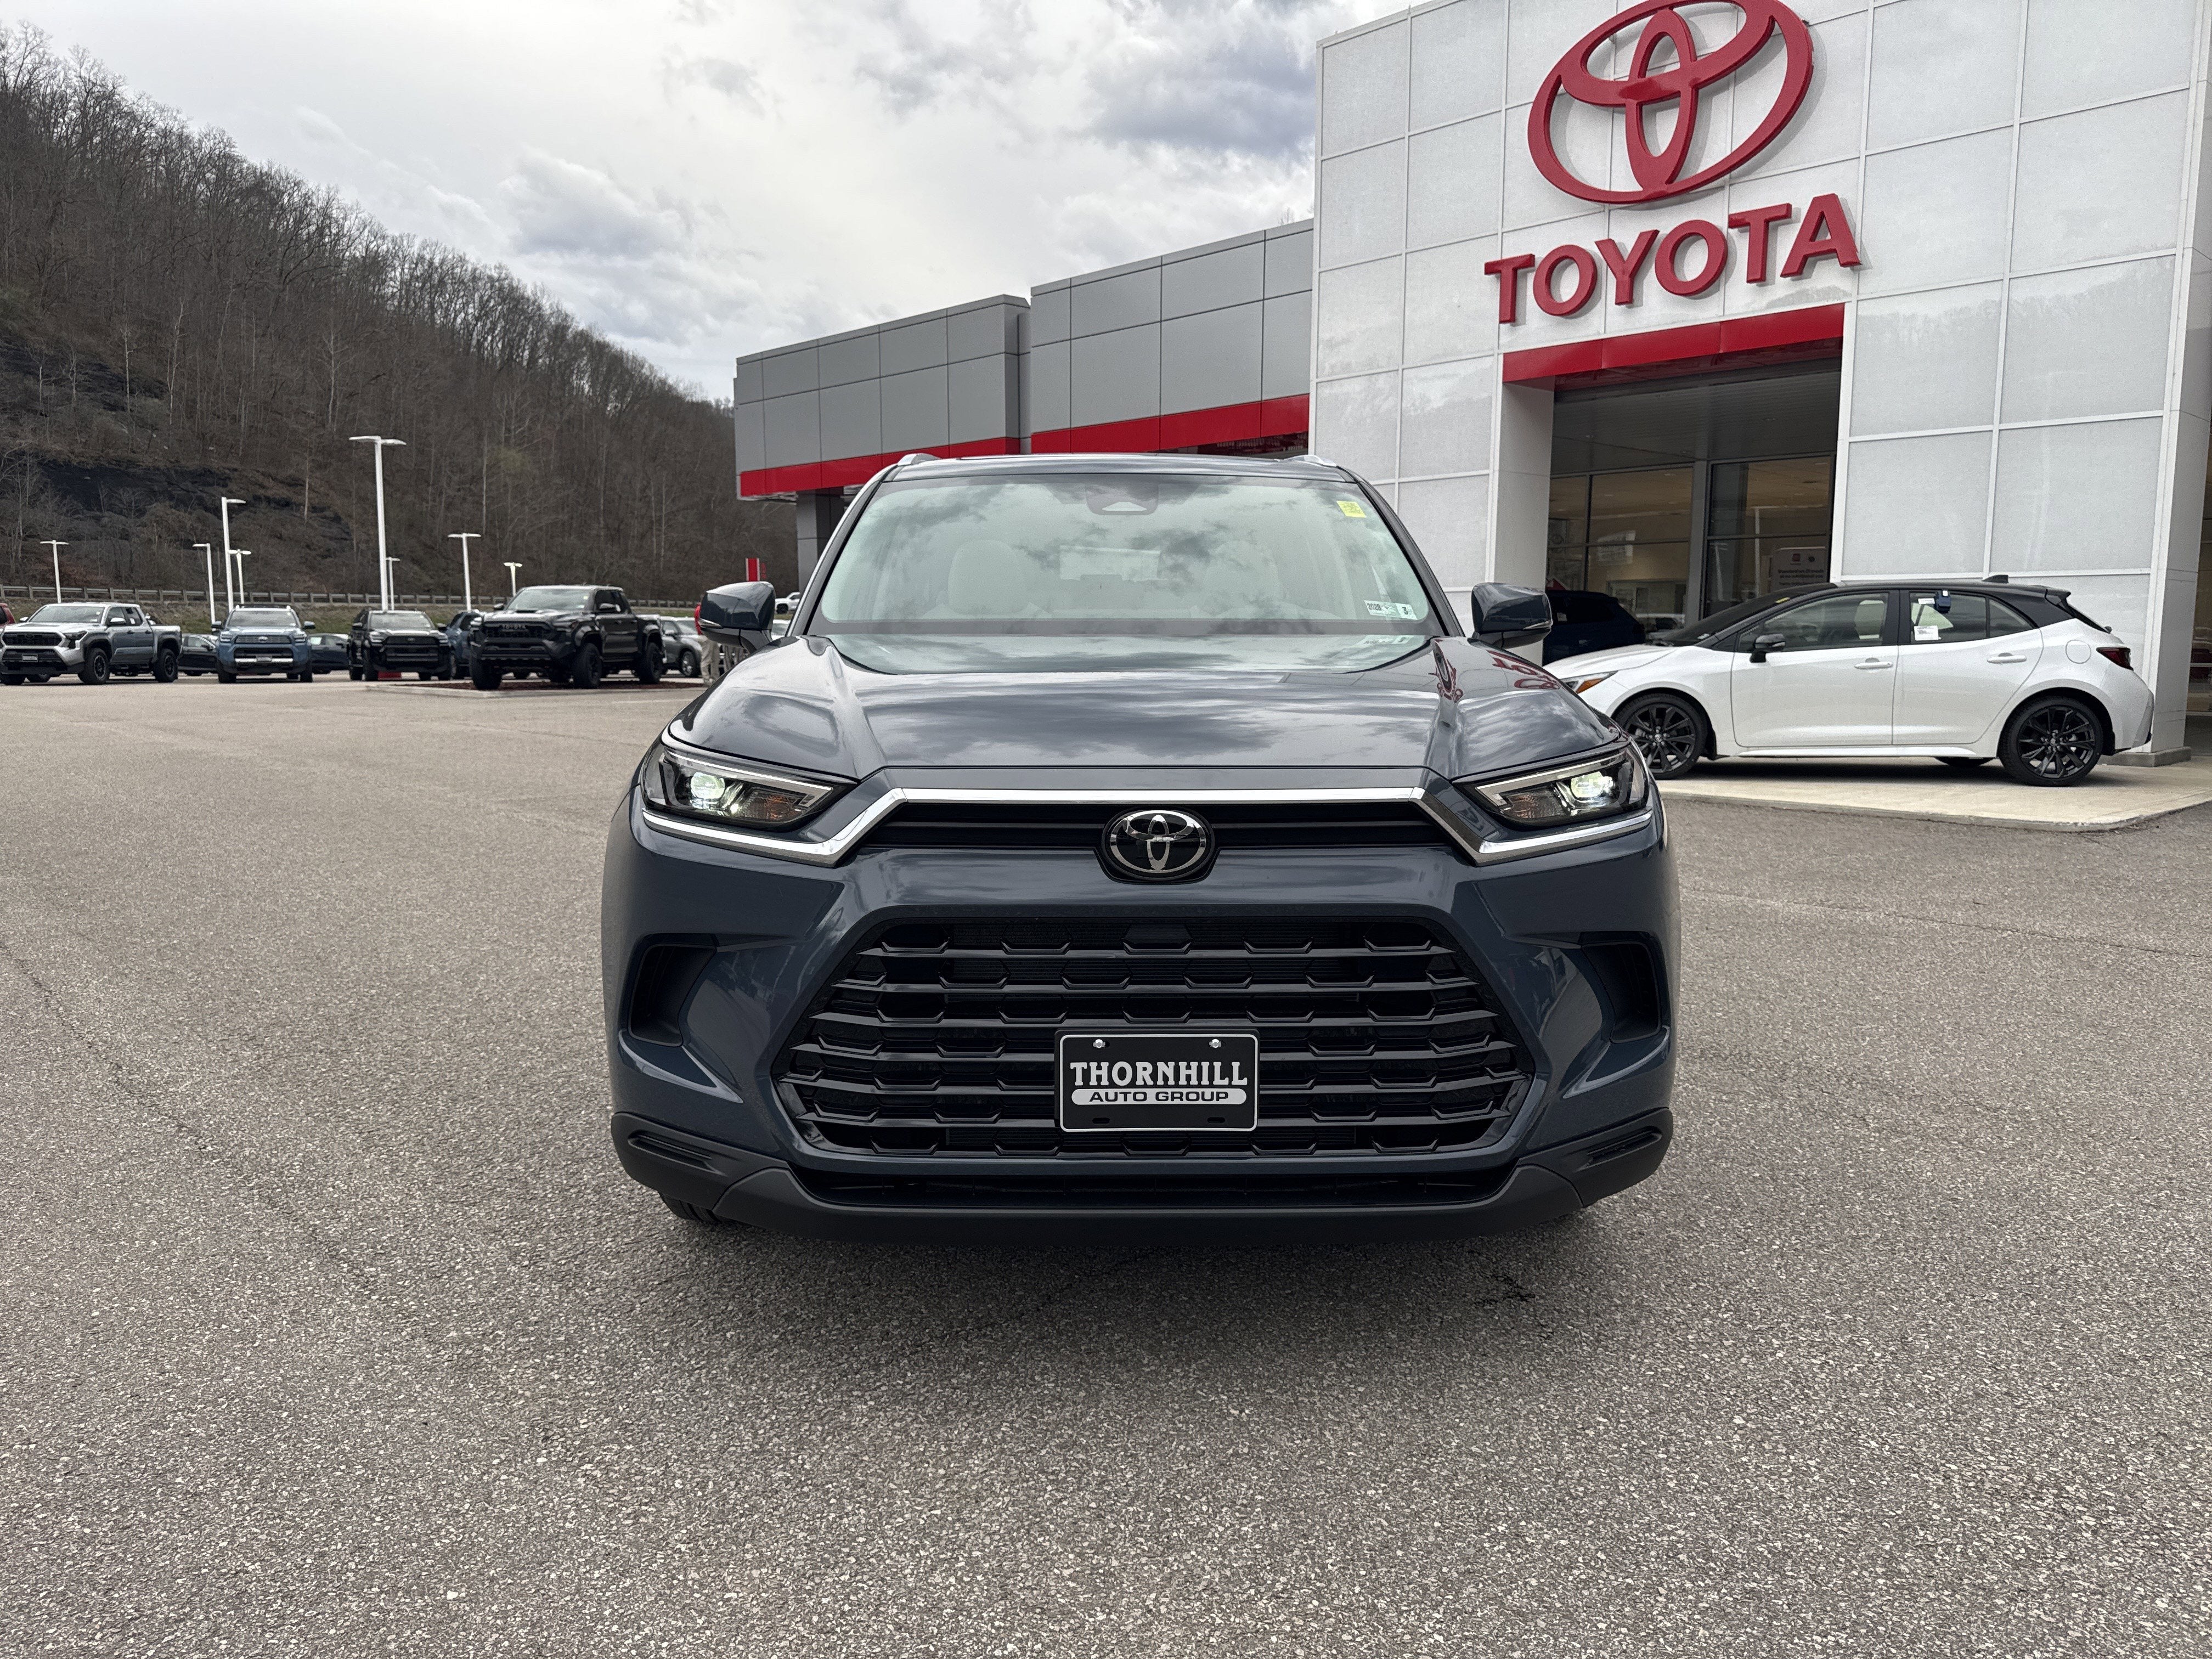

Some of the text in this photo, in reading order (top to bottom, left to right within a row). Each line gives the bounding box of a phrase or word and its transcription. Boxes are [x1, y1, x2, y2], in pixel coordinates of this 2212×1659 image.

[1484, 193, 1862, 324] TOYOTA
[1402, 607, 1408, 615] 3
[1070, 1061, 1248, 1086] THORNHILL
[1089, 1091, 1229, 1102] AUTO GROUP
